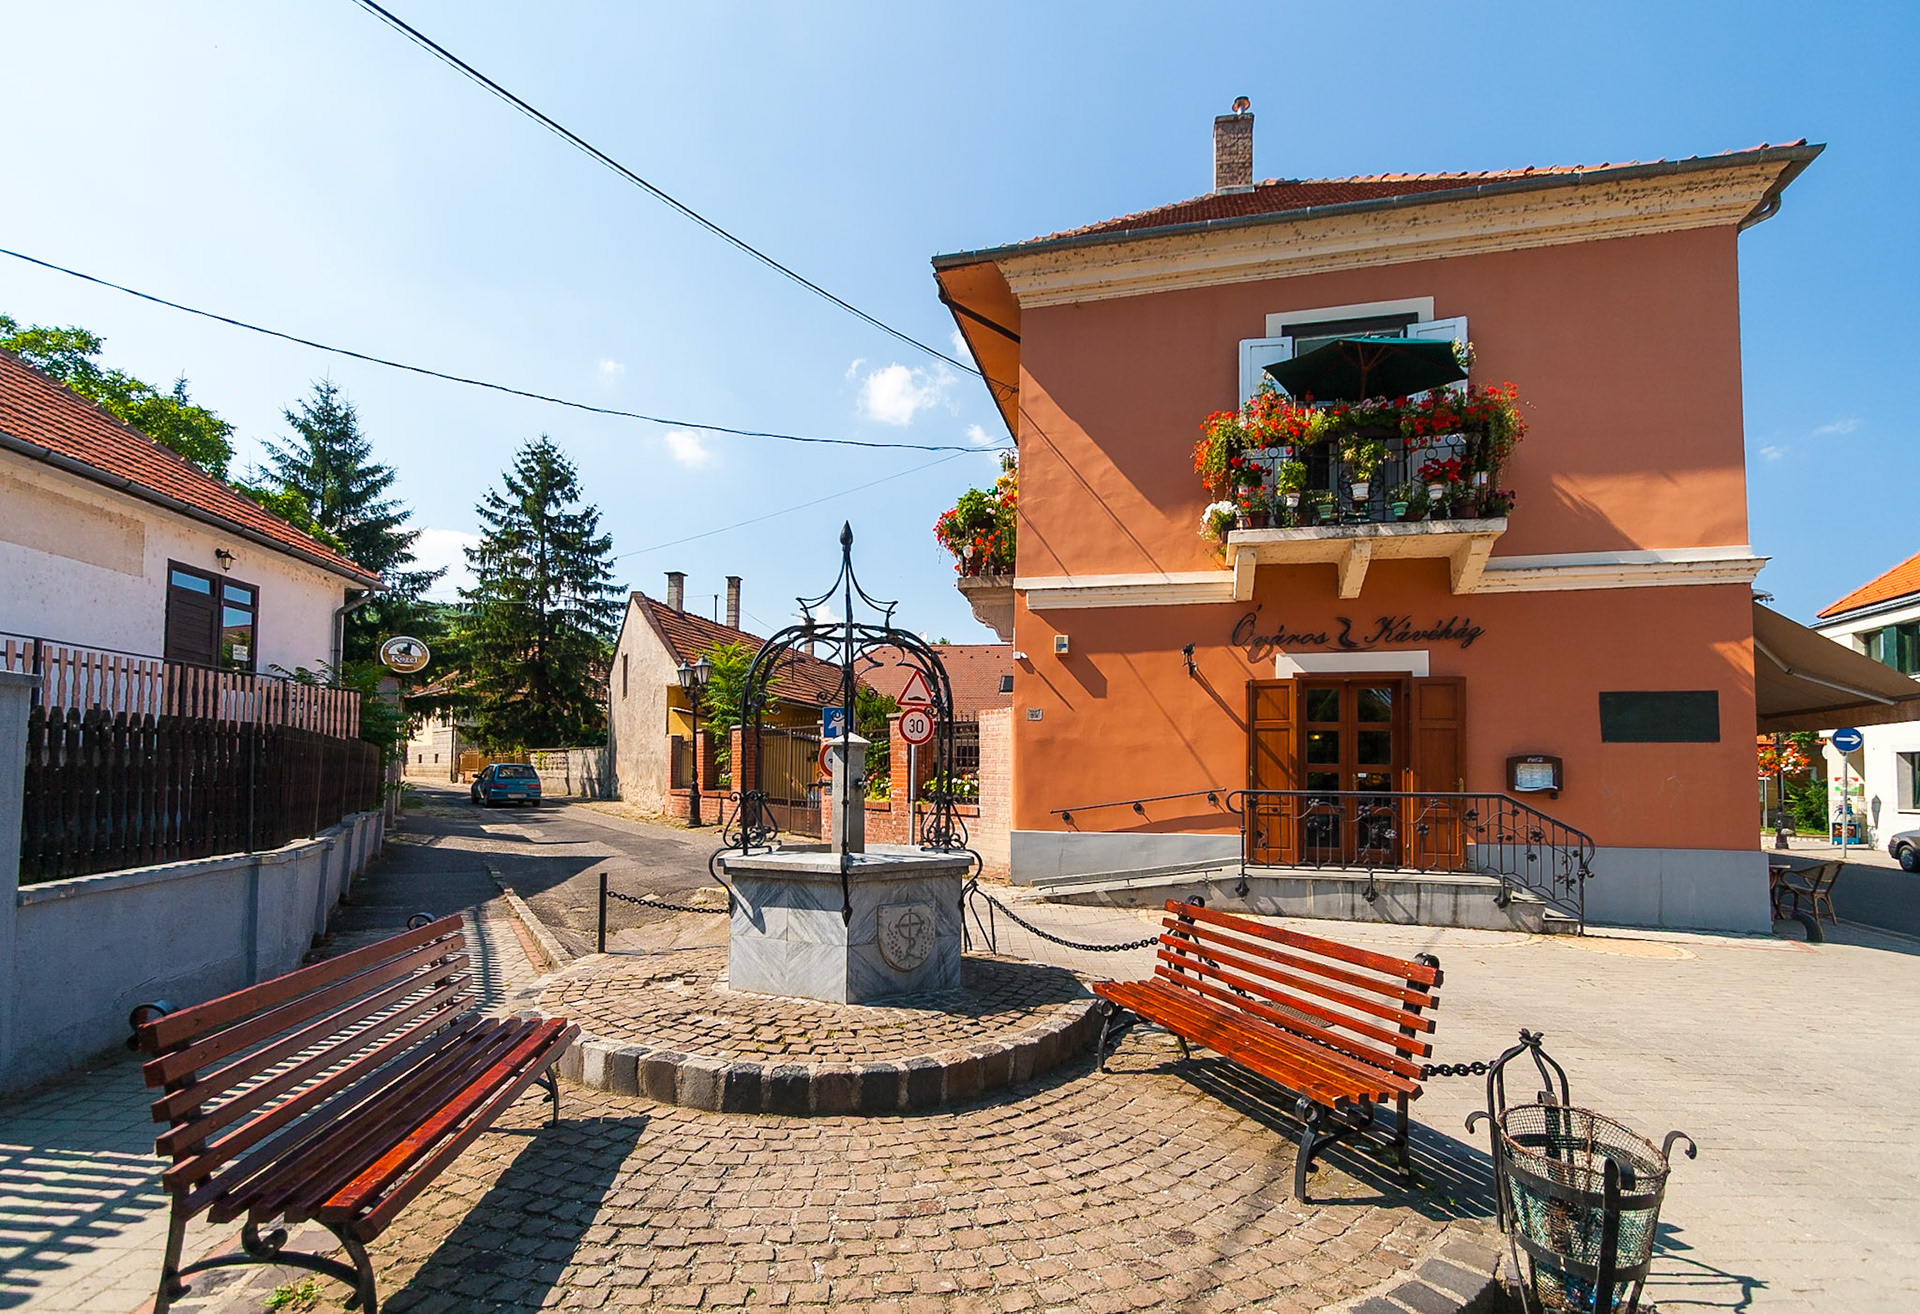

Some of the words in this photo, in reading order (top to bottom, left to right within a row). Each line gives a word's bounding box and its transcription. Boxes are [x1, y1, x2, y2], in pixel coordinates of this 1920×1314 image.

[1231, 603, 1330, 648] Óváros
[1363, 614, 1487, 649] Kávéház
[908, 718, 924, 734] 30
